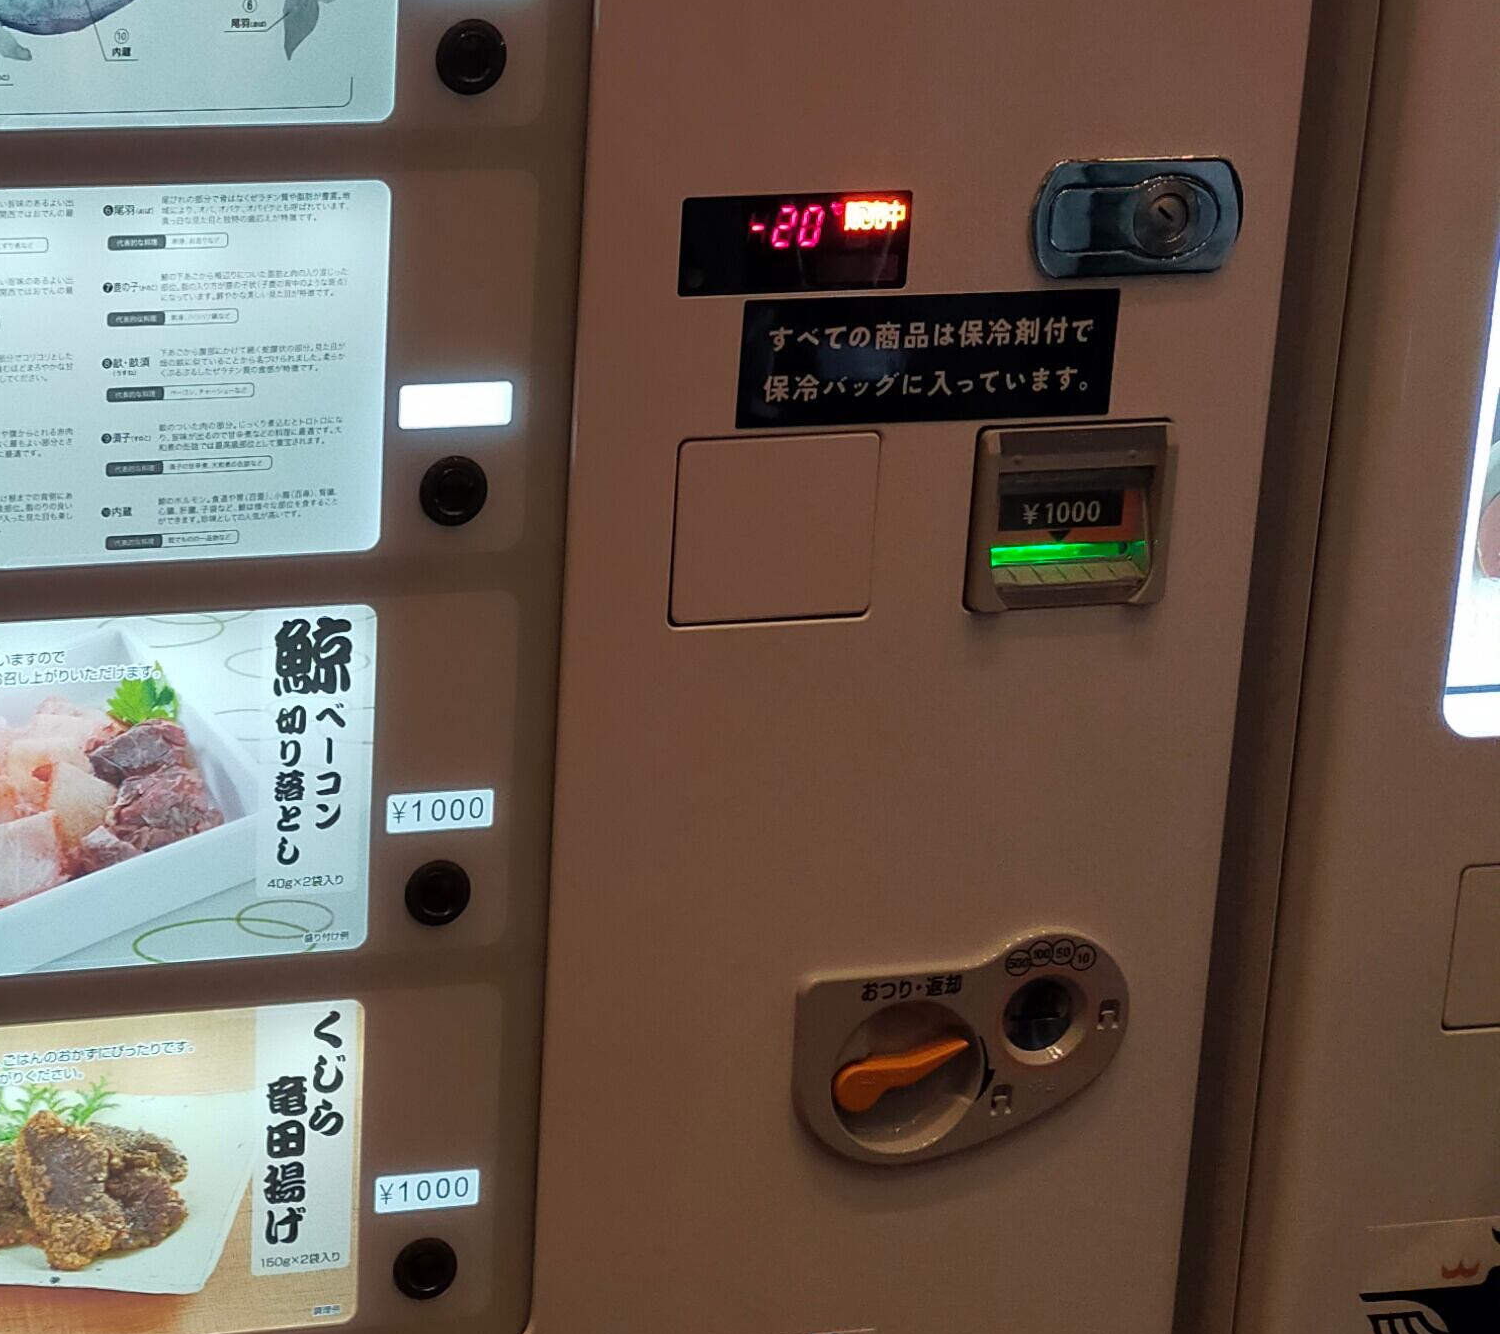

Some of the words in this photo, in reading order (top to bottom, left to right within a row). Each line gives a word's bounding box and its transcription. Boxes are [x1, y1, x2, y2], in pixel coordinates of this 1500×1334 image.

[768, 317, 1095, 352] すべての商品は保冷剤付で
[763, 365, 1090, 403] 保冷バッグに入っています。
[1022, 500, 1101, 526] ¥1000
[274, 616, 352, 696] 鯨
[315, 702, 346, 830] ベーコン
[274, 705, 307, 866] 切り落とし
[393, 796, 484, 824] ¥1000
[1078, 953, 1090, 964] 10
[861, 974, 962, 1002] おつり・返却
[309, 1011, 347, 1136] くじら
[264, 1076, 307, 1245] 竜田揚げ
[380, 1176, 469, 1205] ¥1000
